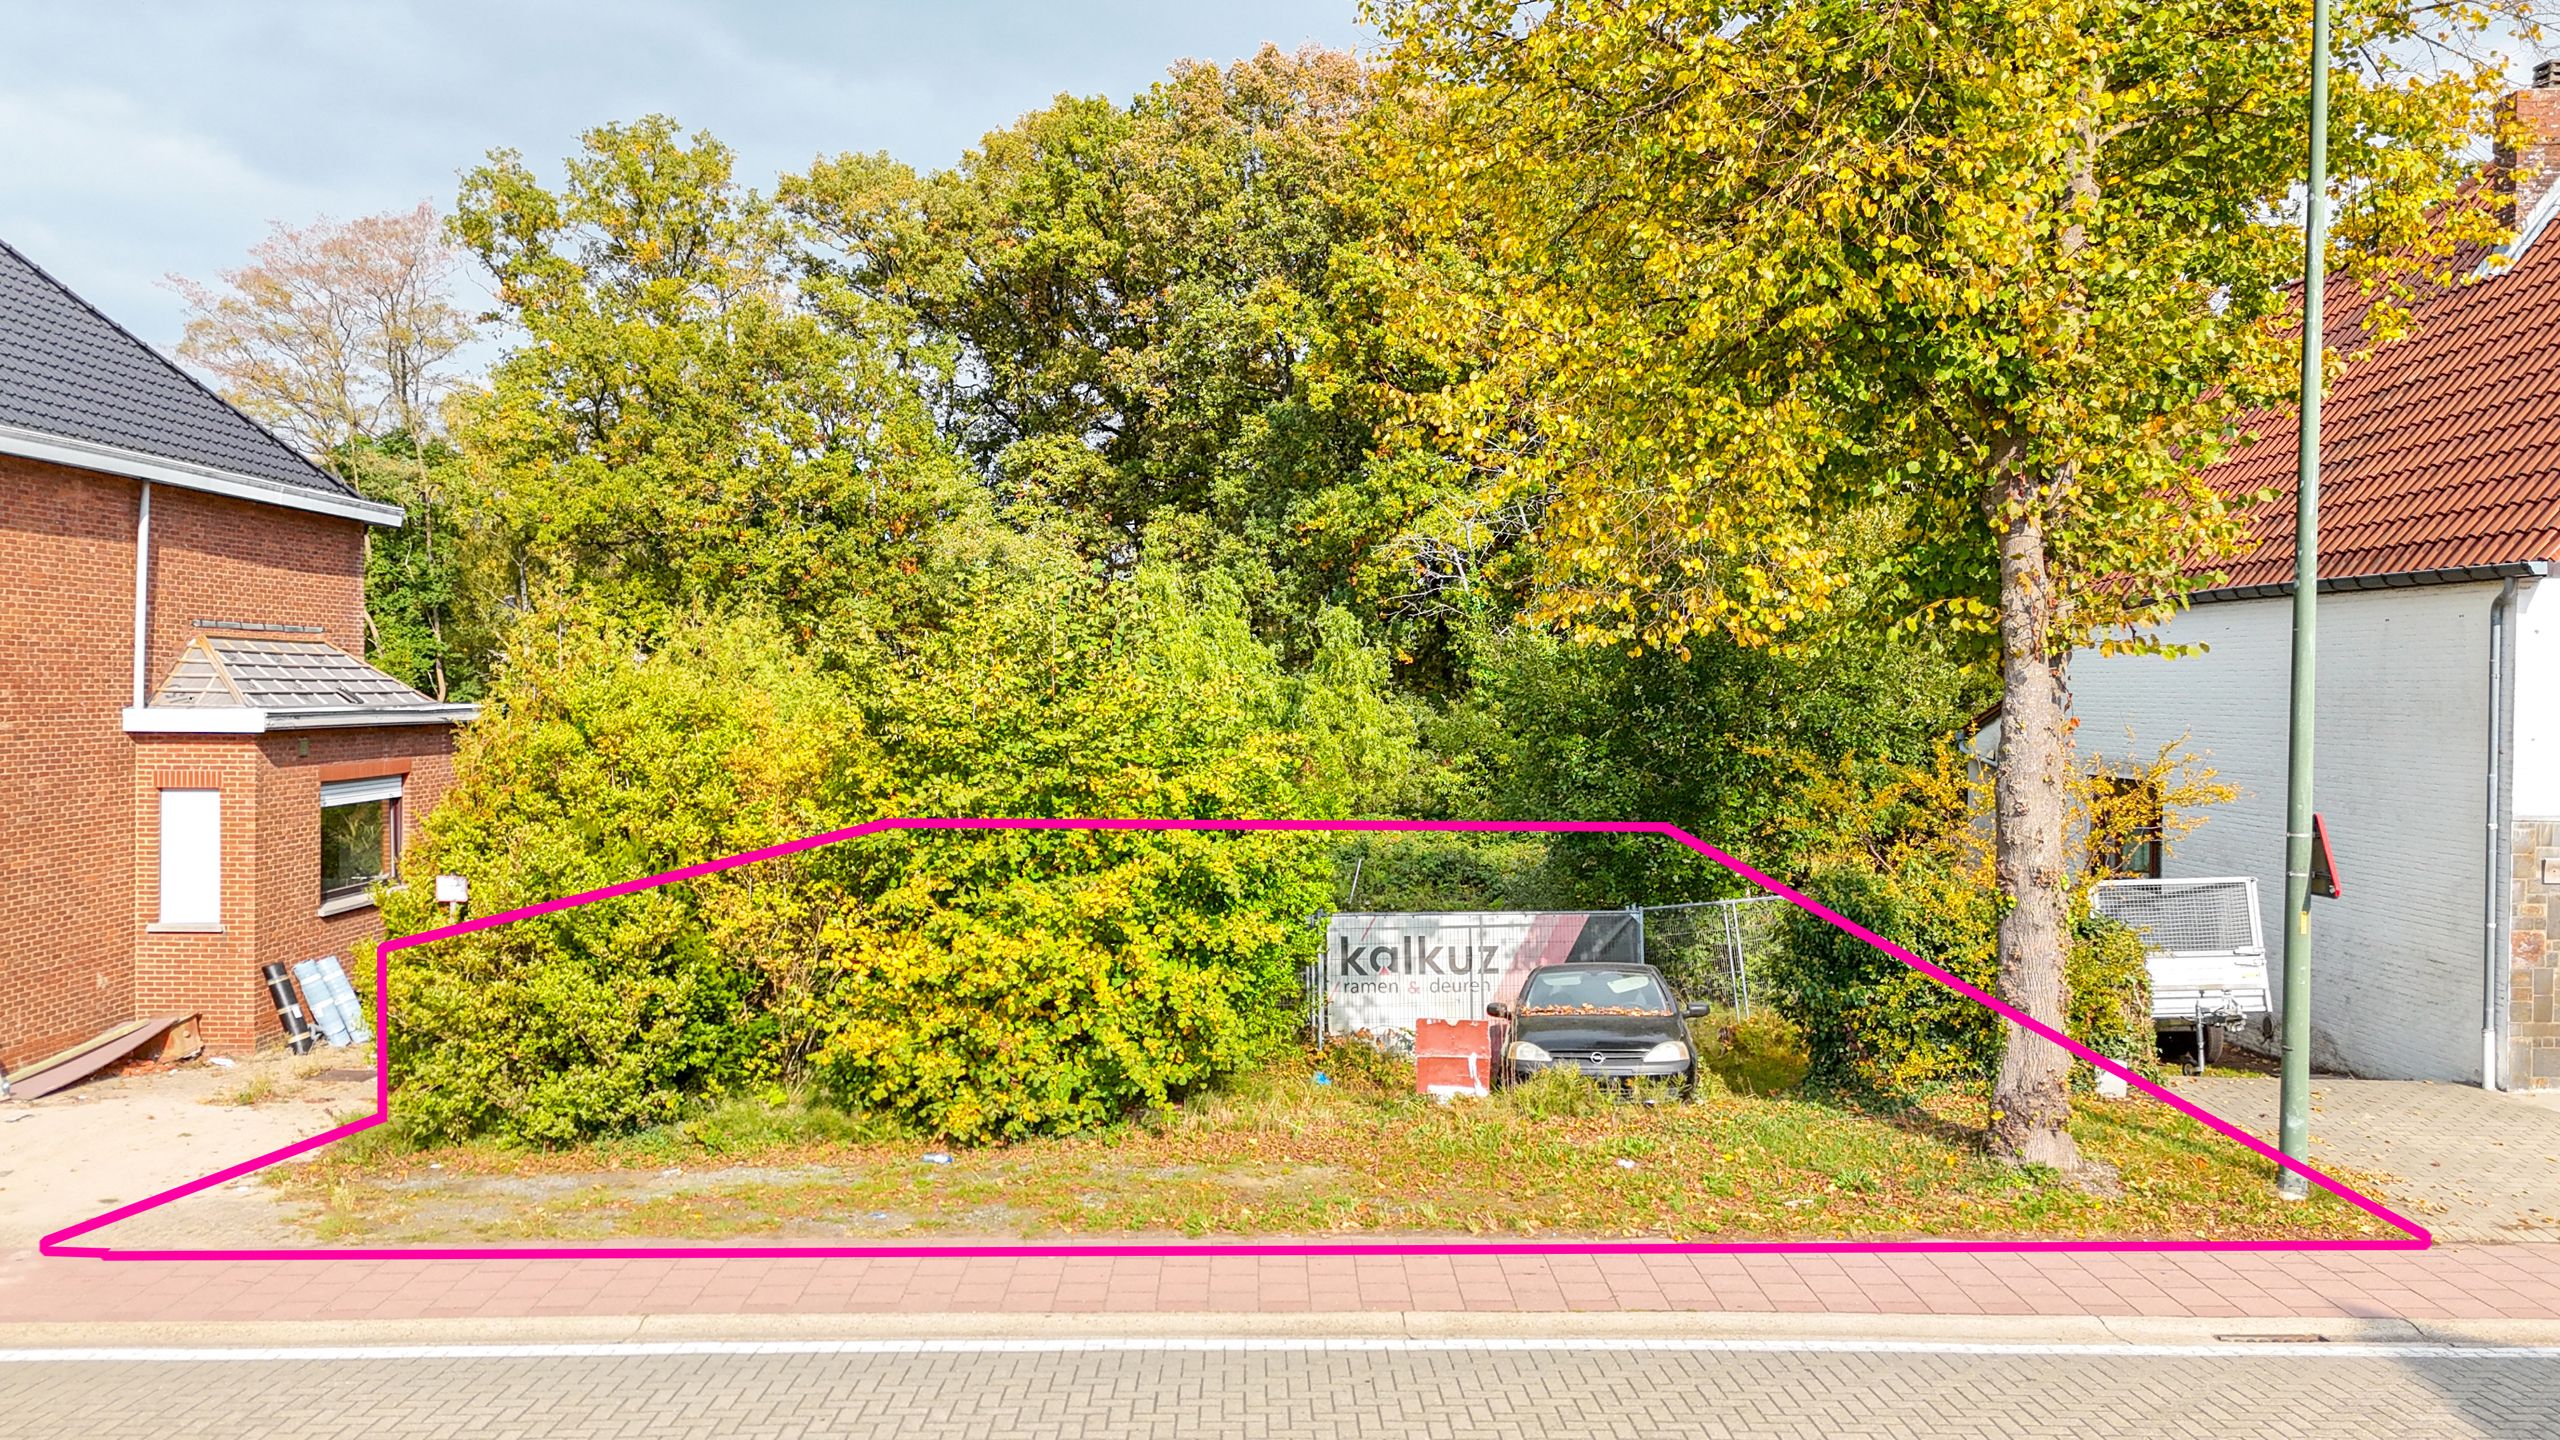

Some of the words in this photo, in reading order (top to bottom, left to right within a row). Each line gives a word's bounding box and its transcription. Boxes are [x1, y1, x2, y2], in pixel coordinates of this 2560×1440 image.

[1340, 935, 1499, 976] kalkuz
[1344, 981, 1399, 994] ramen
[1407, 980, 1420, 994] &
[1429, 977, 1491, 993] deuren
